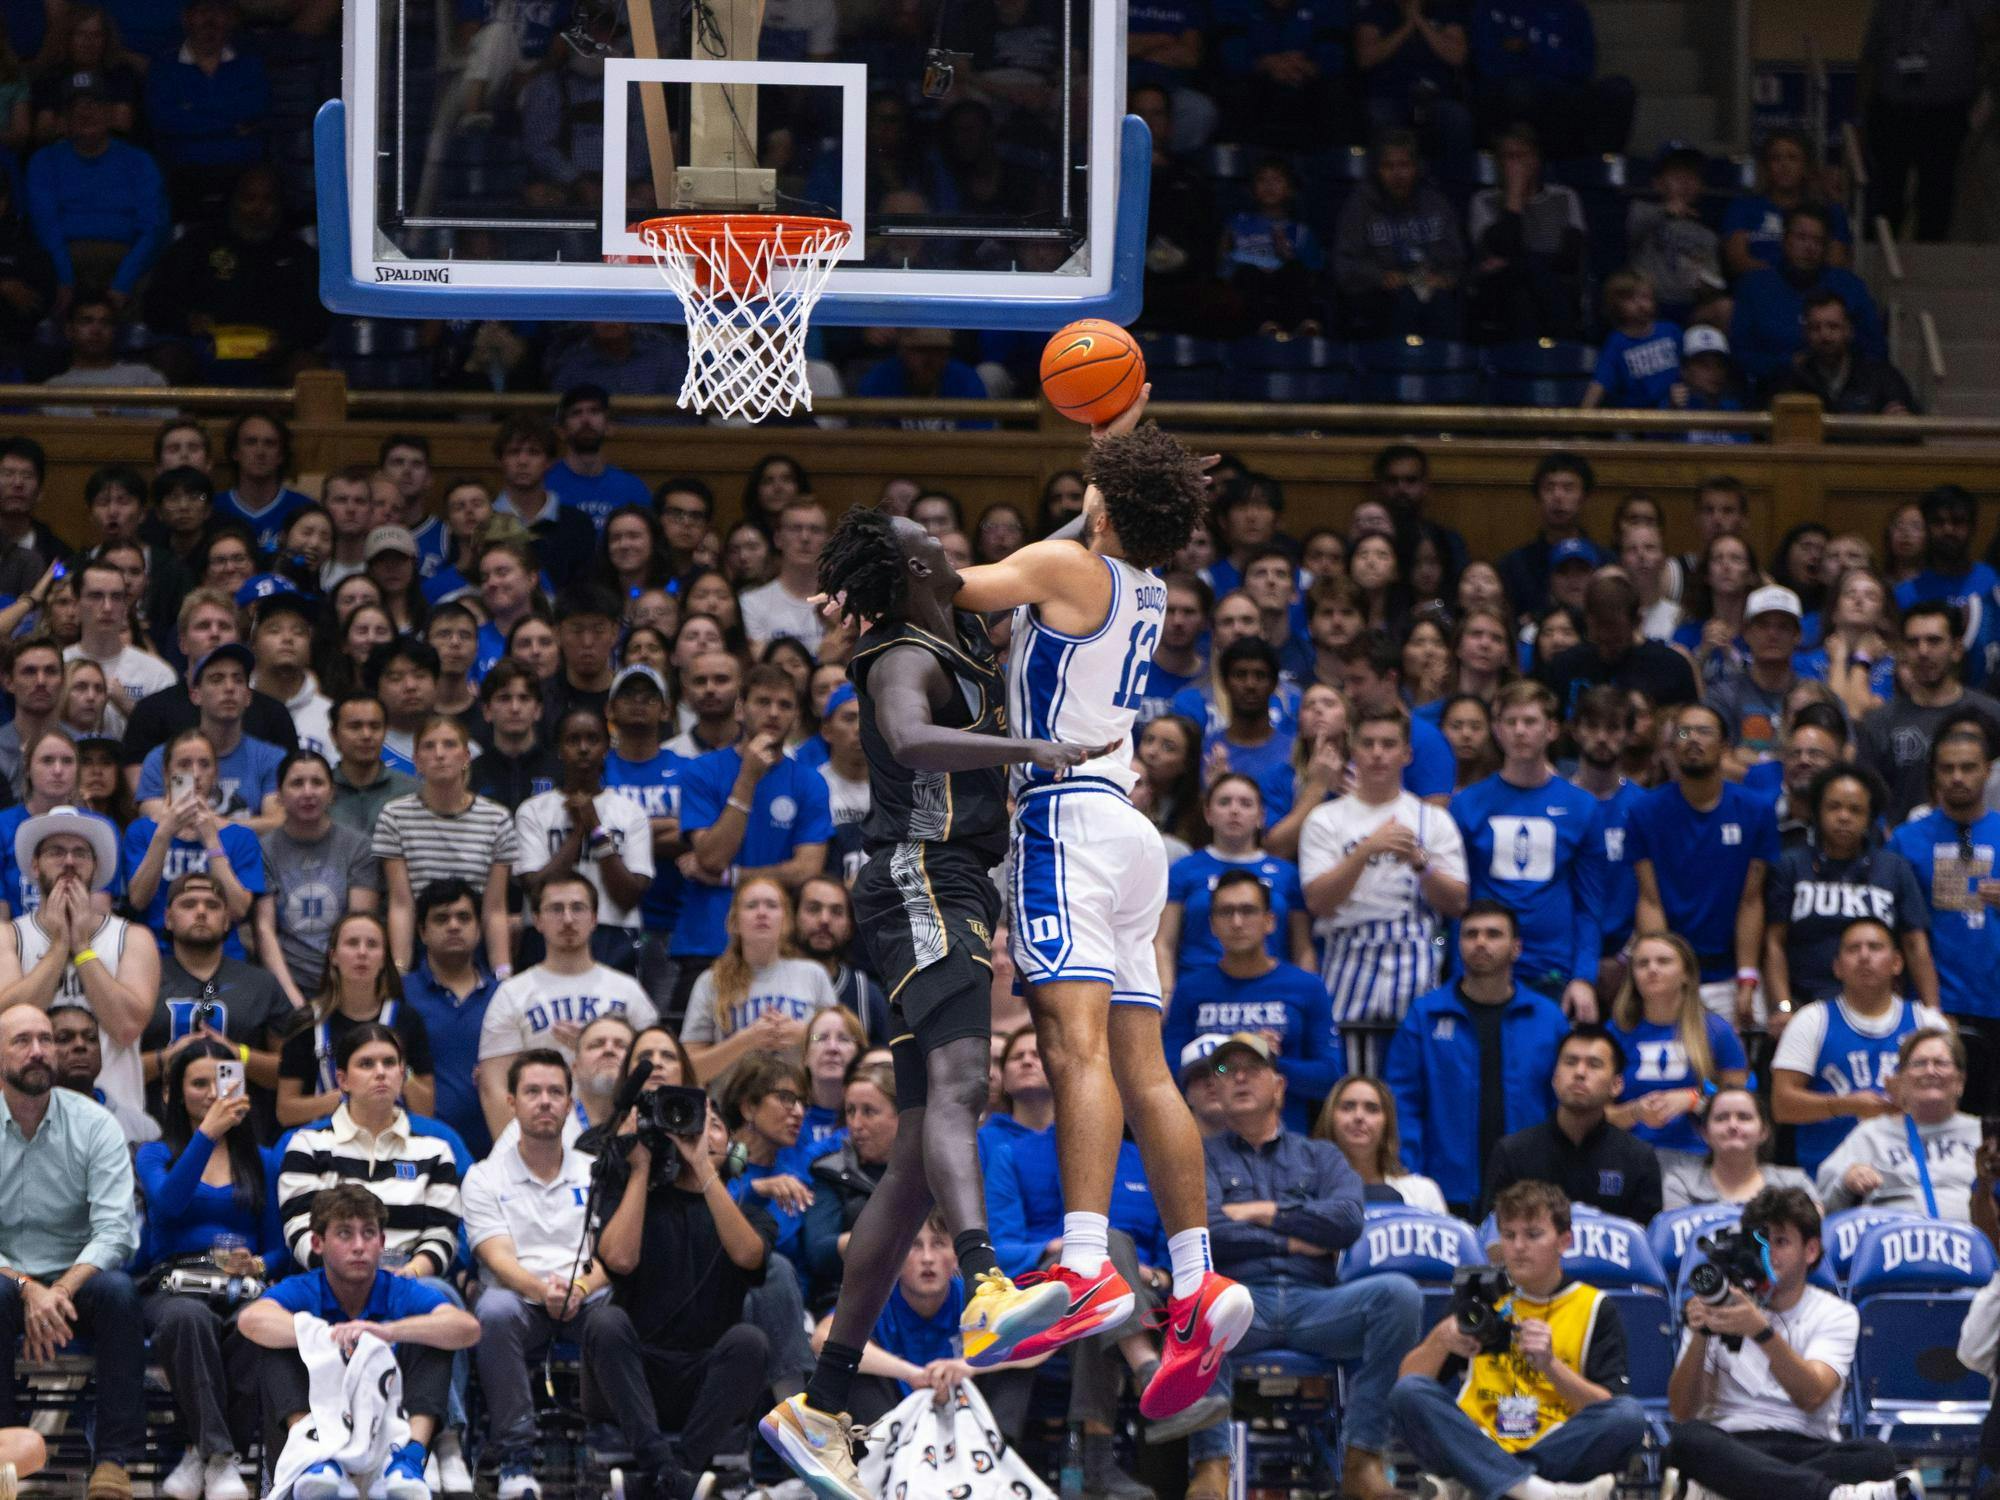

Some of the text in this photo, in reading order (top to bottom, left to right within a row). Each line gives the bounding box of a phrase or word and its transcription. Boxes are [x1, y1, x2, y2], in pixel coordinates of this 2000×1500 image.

[375, 267, 449, 284] SPALDING
[1112, 620, 1158, 710] 12
[1488, 816, 1557, 882] D
[1792, 880, 1895, 929] DUKE
[1029, 915, 1060, 943] D
[1196, 1001, 1287, 1028] DUKE
[1822, 1049, 1900, 1097] DUK
[1367, 1222, 1461, 1267] DUKE
[1880, 1228, 1972, 1276] DUKE
